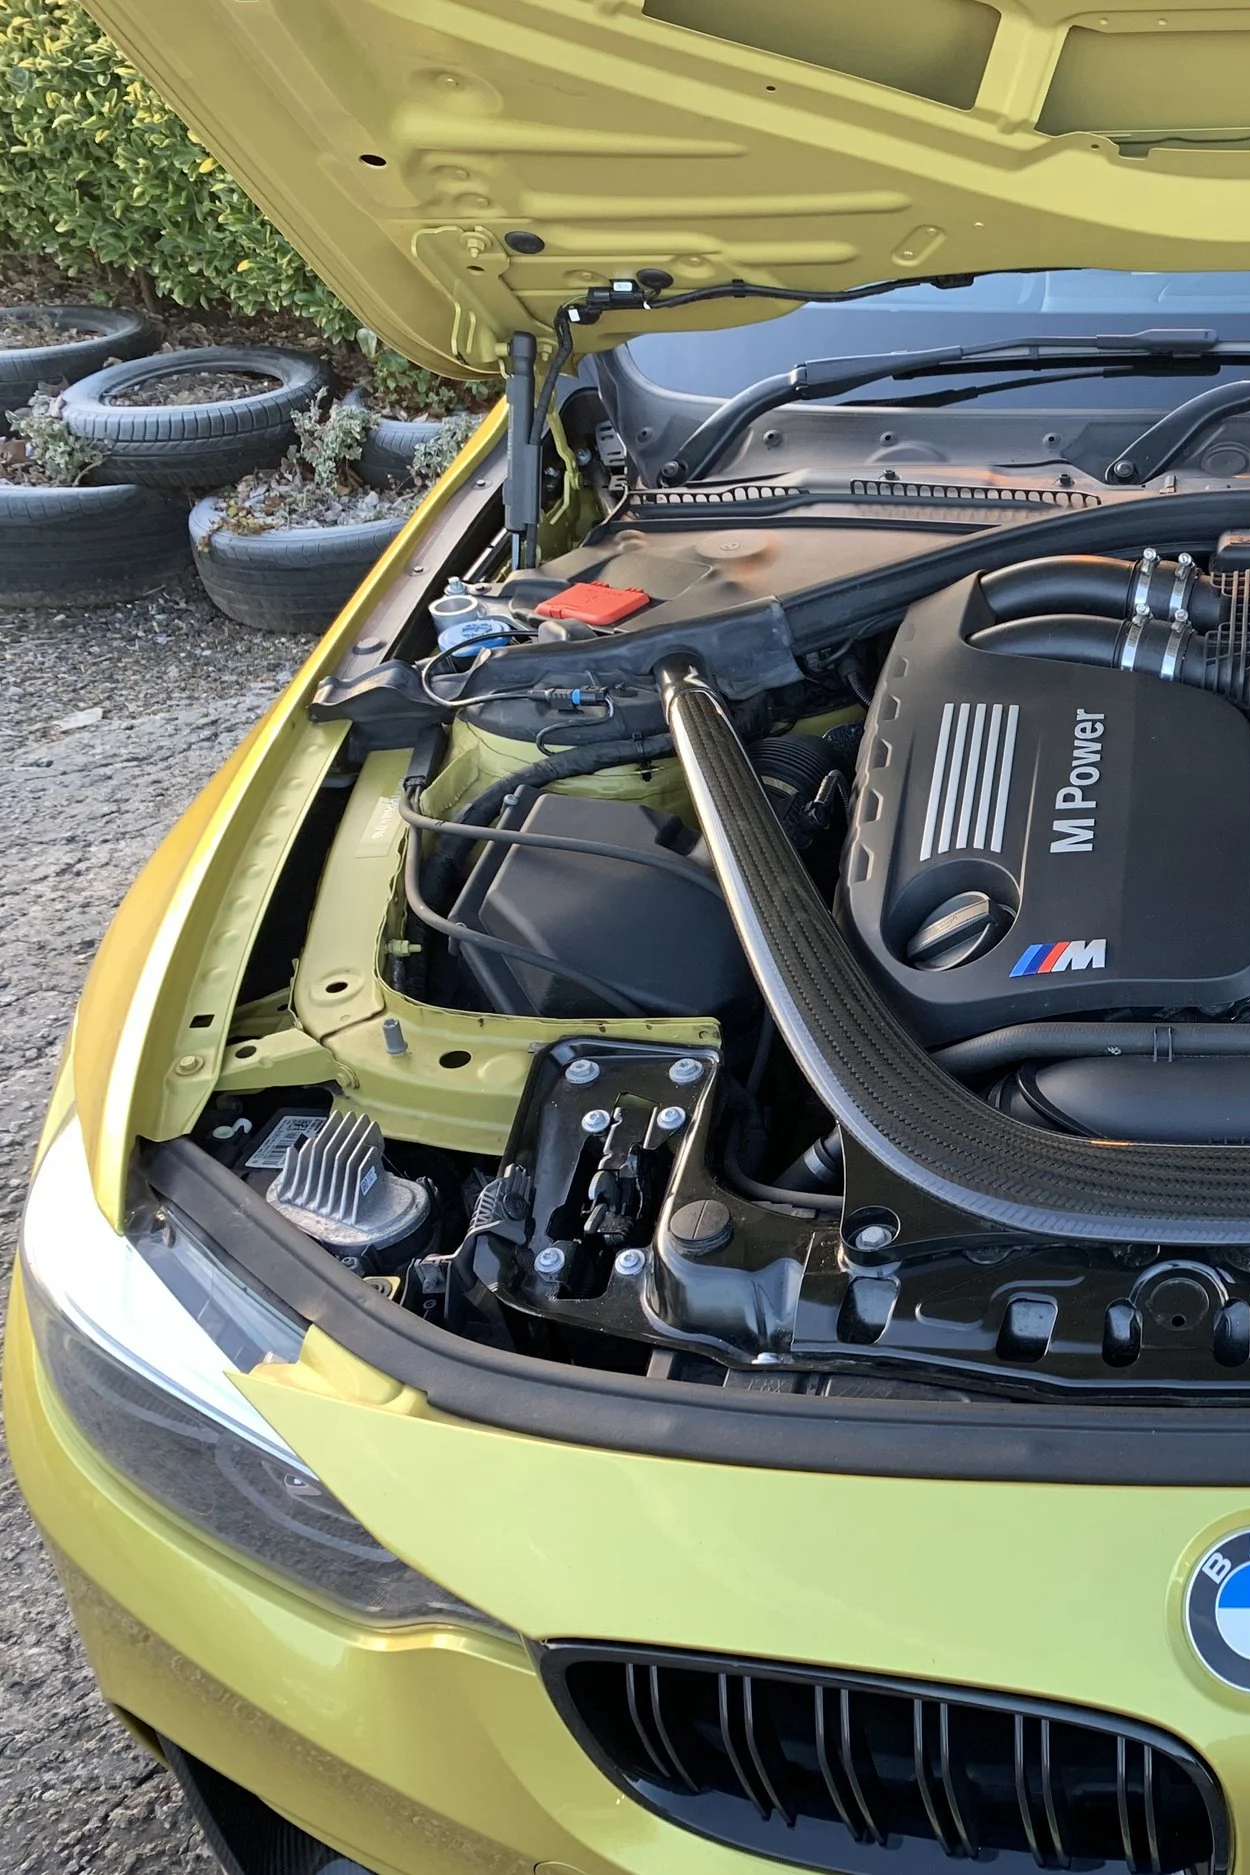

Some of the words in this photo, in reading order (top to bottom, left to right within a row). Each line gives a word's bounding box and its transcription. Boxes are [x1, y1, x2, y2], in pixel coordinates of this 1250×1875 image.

[1054, 708, 1106, 812] Power
[1049, 817, 1096, 854] M
[1047, 938, 1108, 974] M
